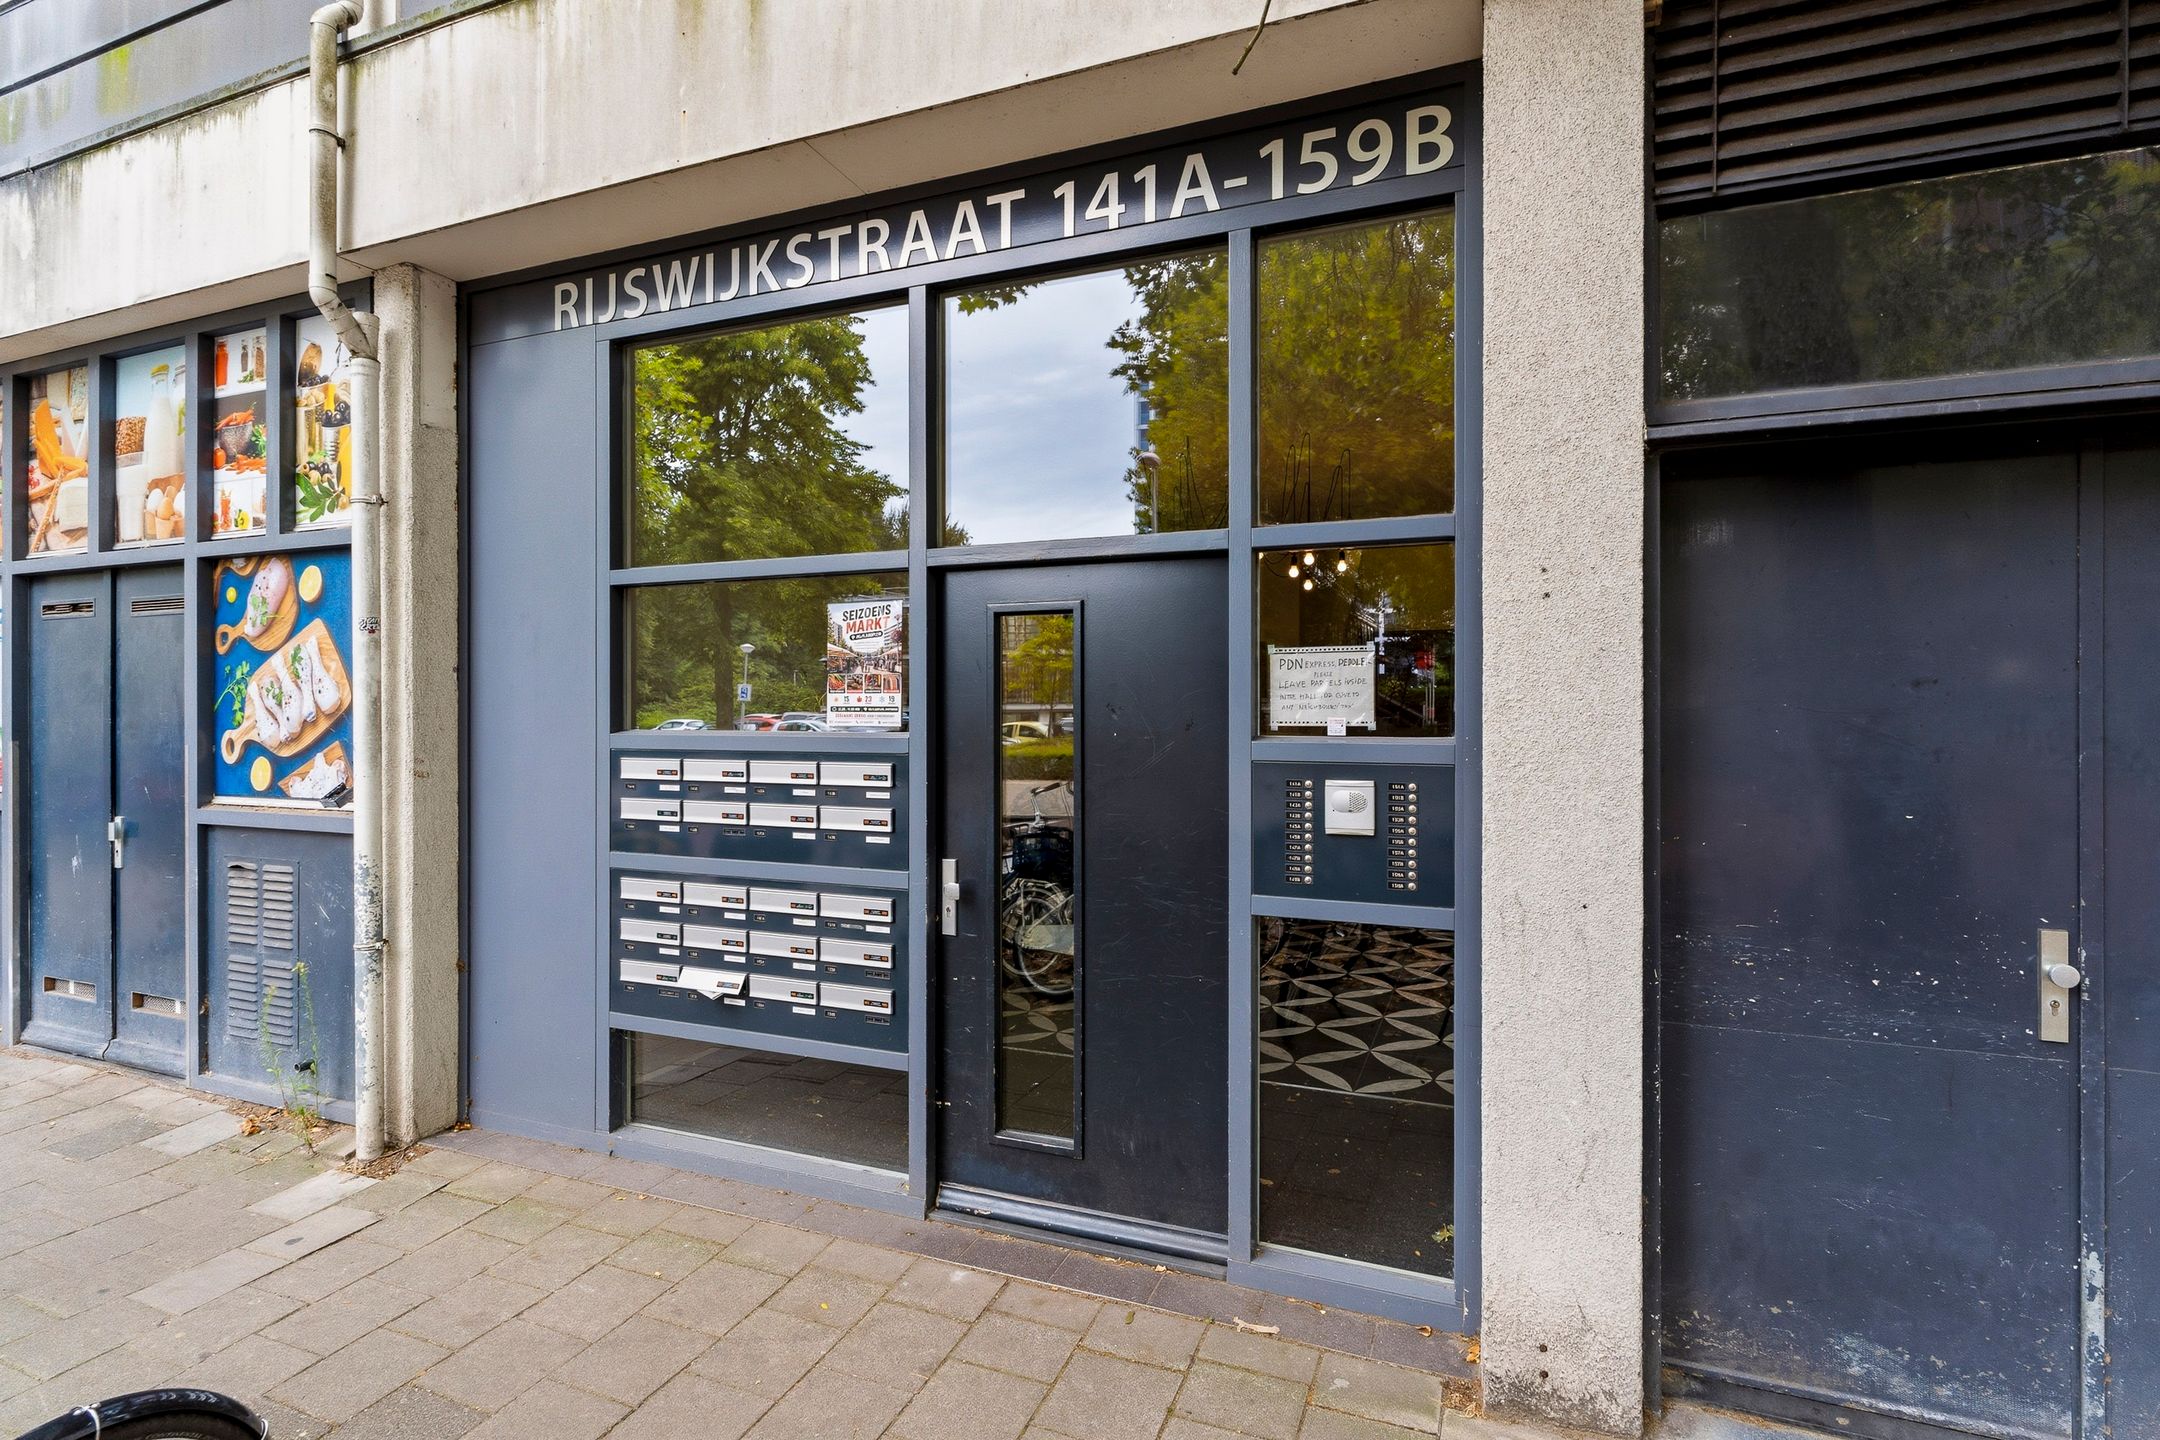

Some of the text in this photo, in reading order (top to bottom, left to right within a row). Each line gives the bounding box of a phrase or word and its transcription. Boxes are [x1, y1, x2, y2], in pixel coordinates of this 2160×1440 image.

[553, 104, 1455, 332] RIJSWIJKSTRAAT 141A-159B
[842, 604, 892, 622] SEIZOENS
[846, 616, 891, 634] MARKT
[1279, 680, 1306, 689] LEAVE
[1310, 679, 1342, 687] PARELS
